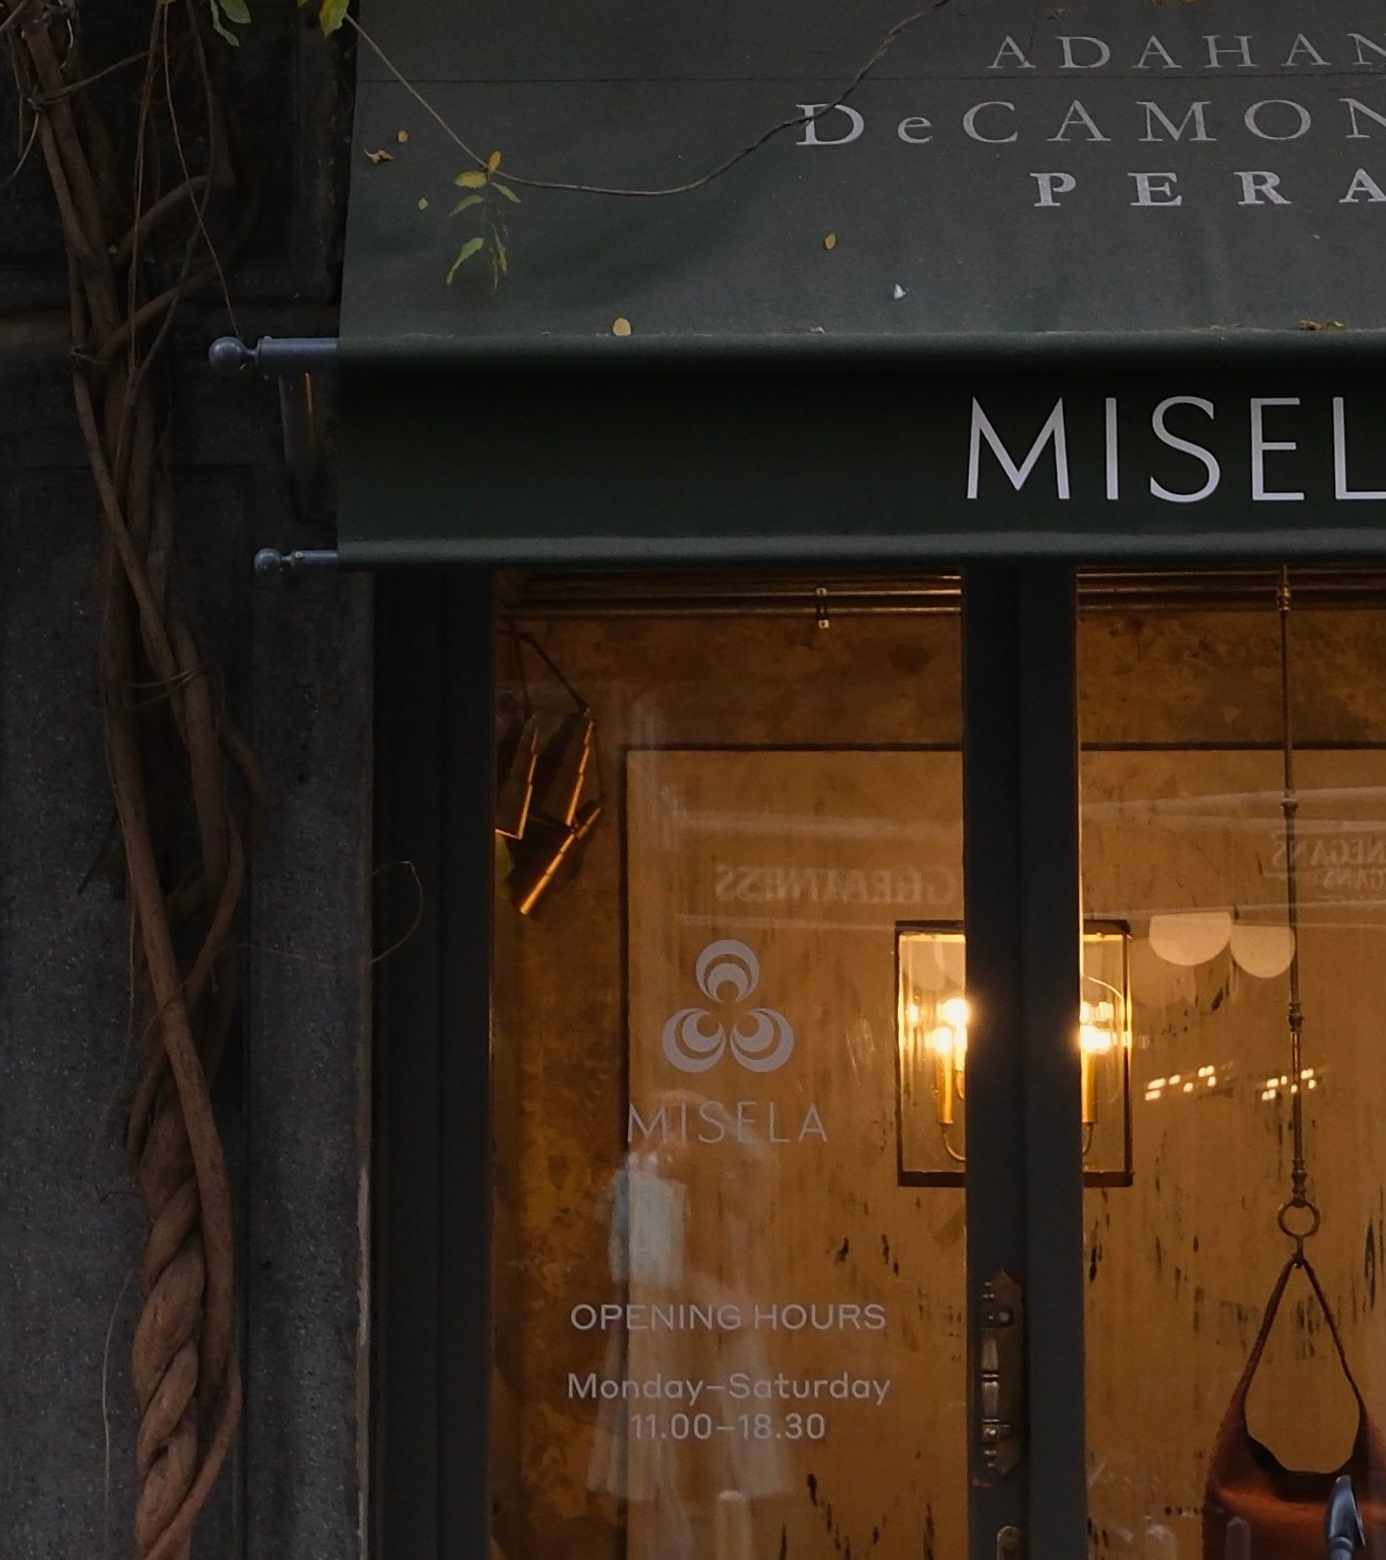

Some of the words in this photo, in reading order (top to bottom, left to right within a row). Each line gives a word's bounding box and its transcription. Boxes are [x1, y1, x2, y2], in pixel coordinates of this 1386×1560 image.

[627, 1100, 829, 1144] MISELA
[570, 1303, 742, 1331] OPENING
[753, 1303, 887, 1331] HOURS
